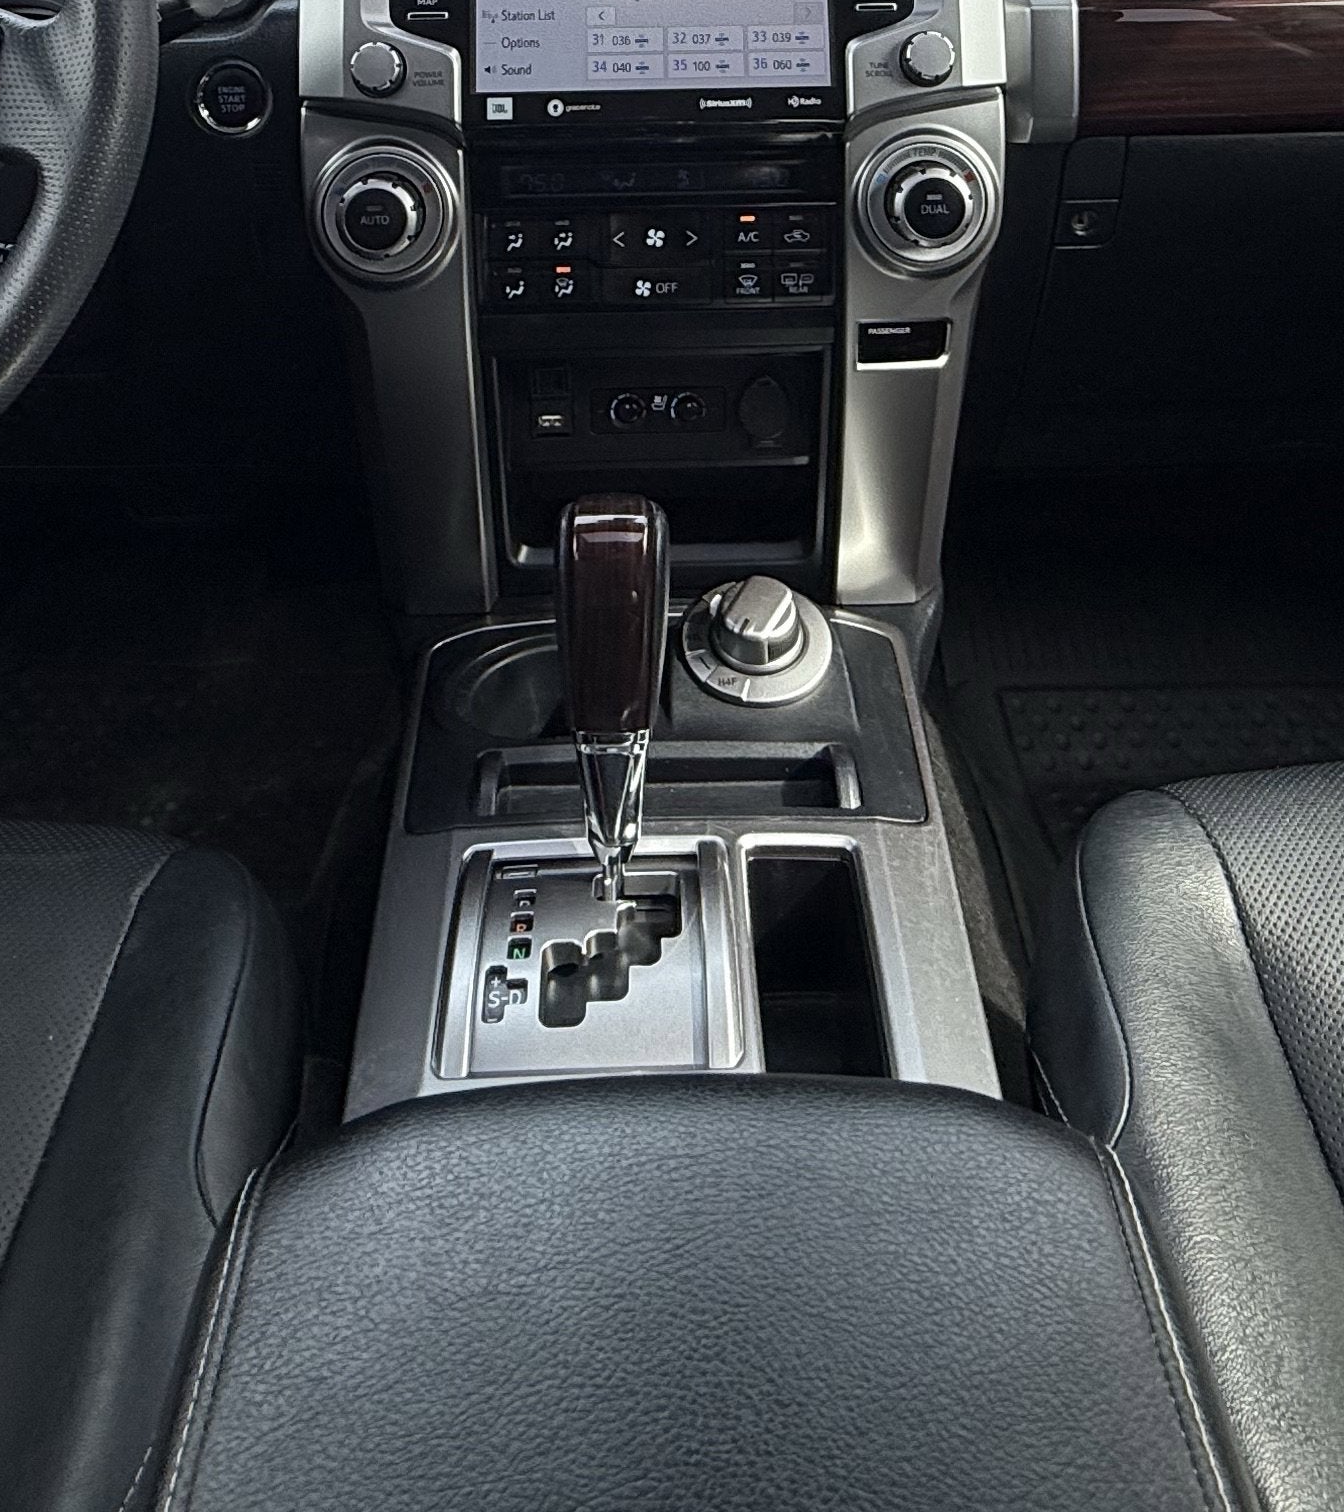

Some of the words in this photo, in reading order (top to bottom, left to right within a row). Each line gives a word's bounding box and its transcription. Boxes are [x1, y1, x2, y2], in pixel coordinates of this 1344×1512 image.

[500, 9, 538, 21] Station
[540, 9, 556, 21] List
[592, 33, 605, 45] 31
[672, 32, 687, 44] 32
[692, 33, 711, 45] 037
[752, 31, 767, 43] 33
[771, 32, 792, 43] 039
[501, 37, 541, 50] Options
[592, 61, 607, 73] 34
[612, 62, 632, 73] 040
[672, 59, 687, 71] 35
[692, 61, 711, 71] 100
[753, 58, 768, 70] 36
[869, 62, 889, 70] TUNE
[414, 71, 443, 79] POWER
[501, 64, 532, 76] Sound
[865, 70, 892, 78] SCROLL
[412, 79, 445, 87] VOLUME
[218, 94, 246, 103] START
[800, 98, 822, 106] Radio
[220, 104, 246, 113] STOP
[920, 204, 950, 215] DUAL
[360, 215, 390, 225] AUTO
[737, 231, 759, 243] A/C
[656, 282, 679, 293] OFF
[735, 286, 761, 295] FRONT
[513, 948, 526, 959] N
